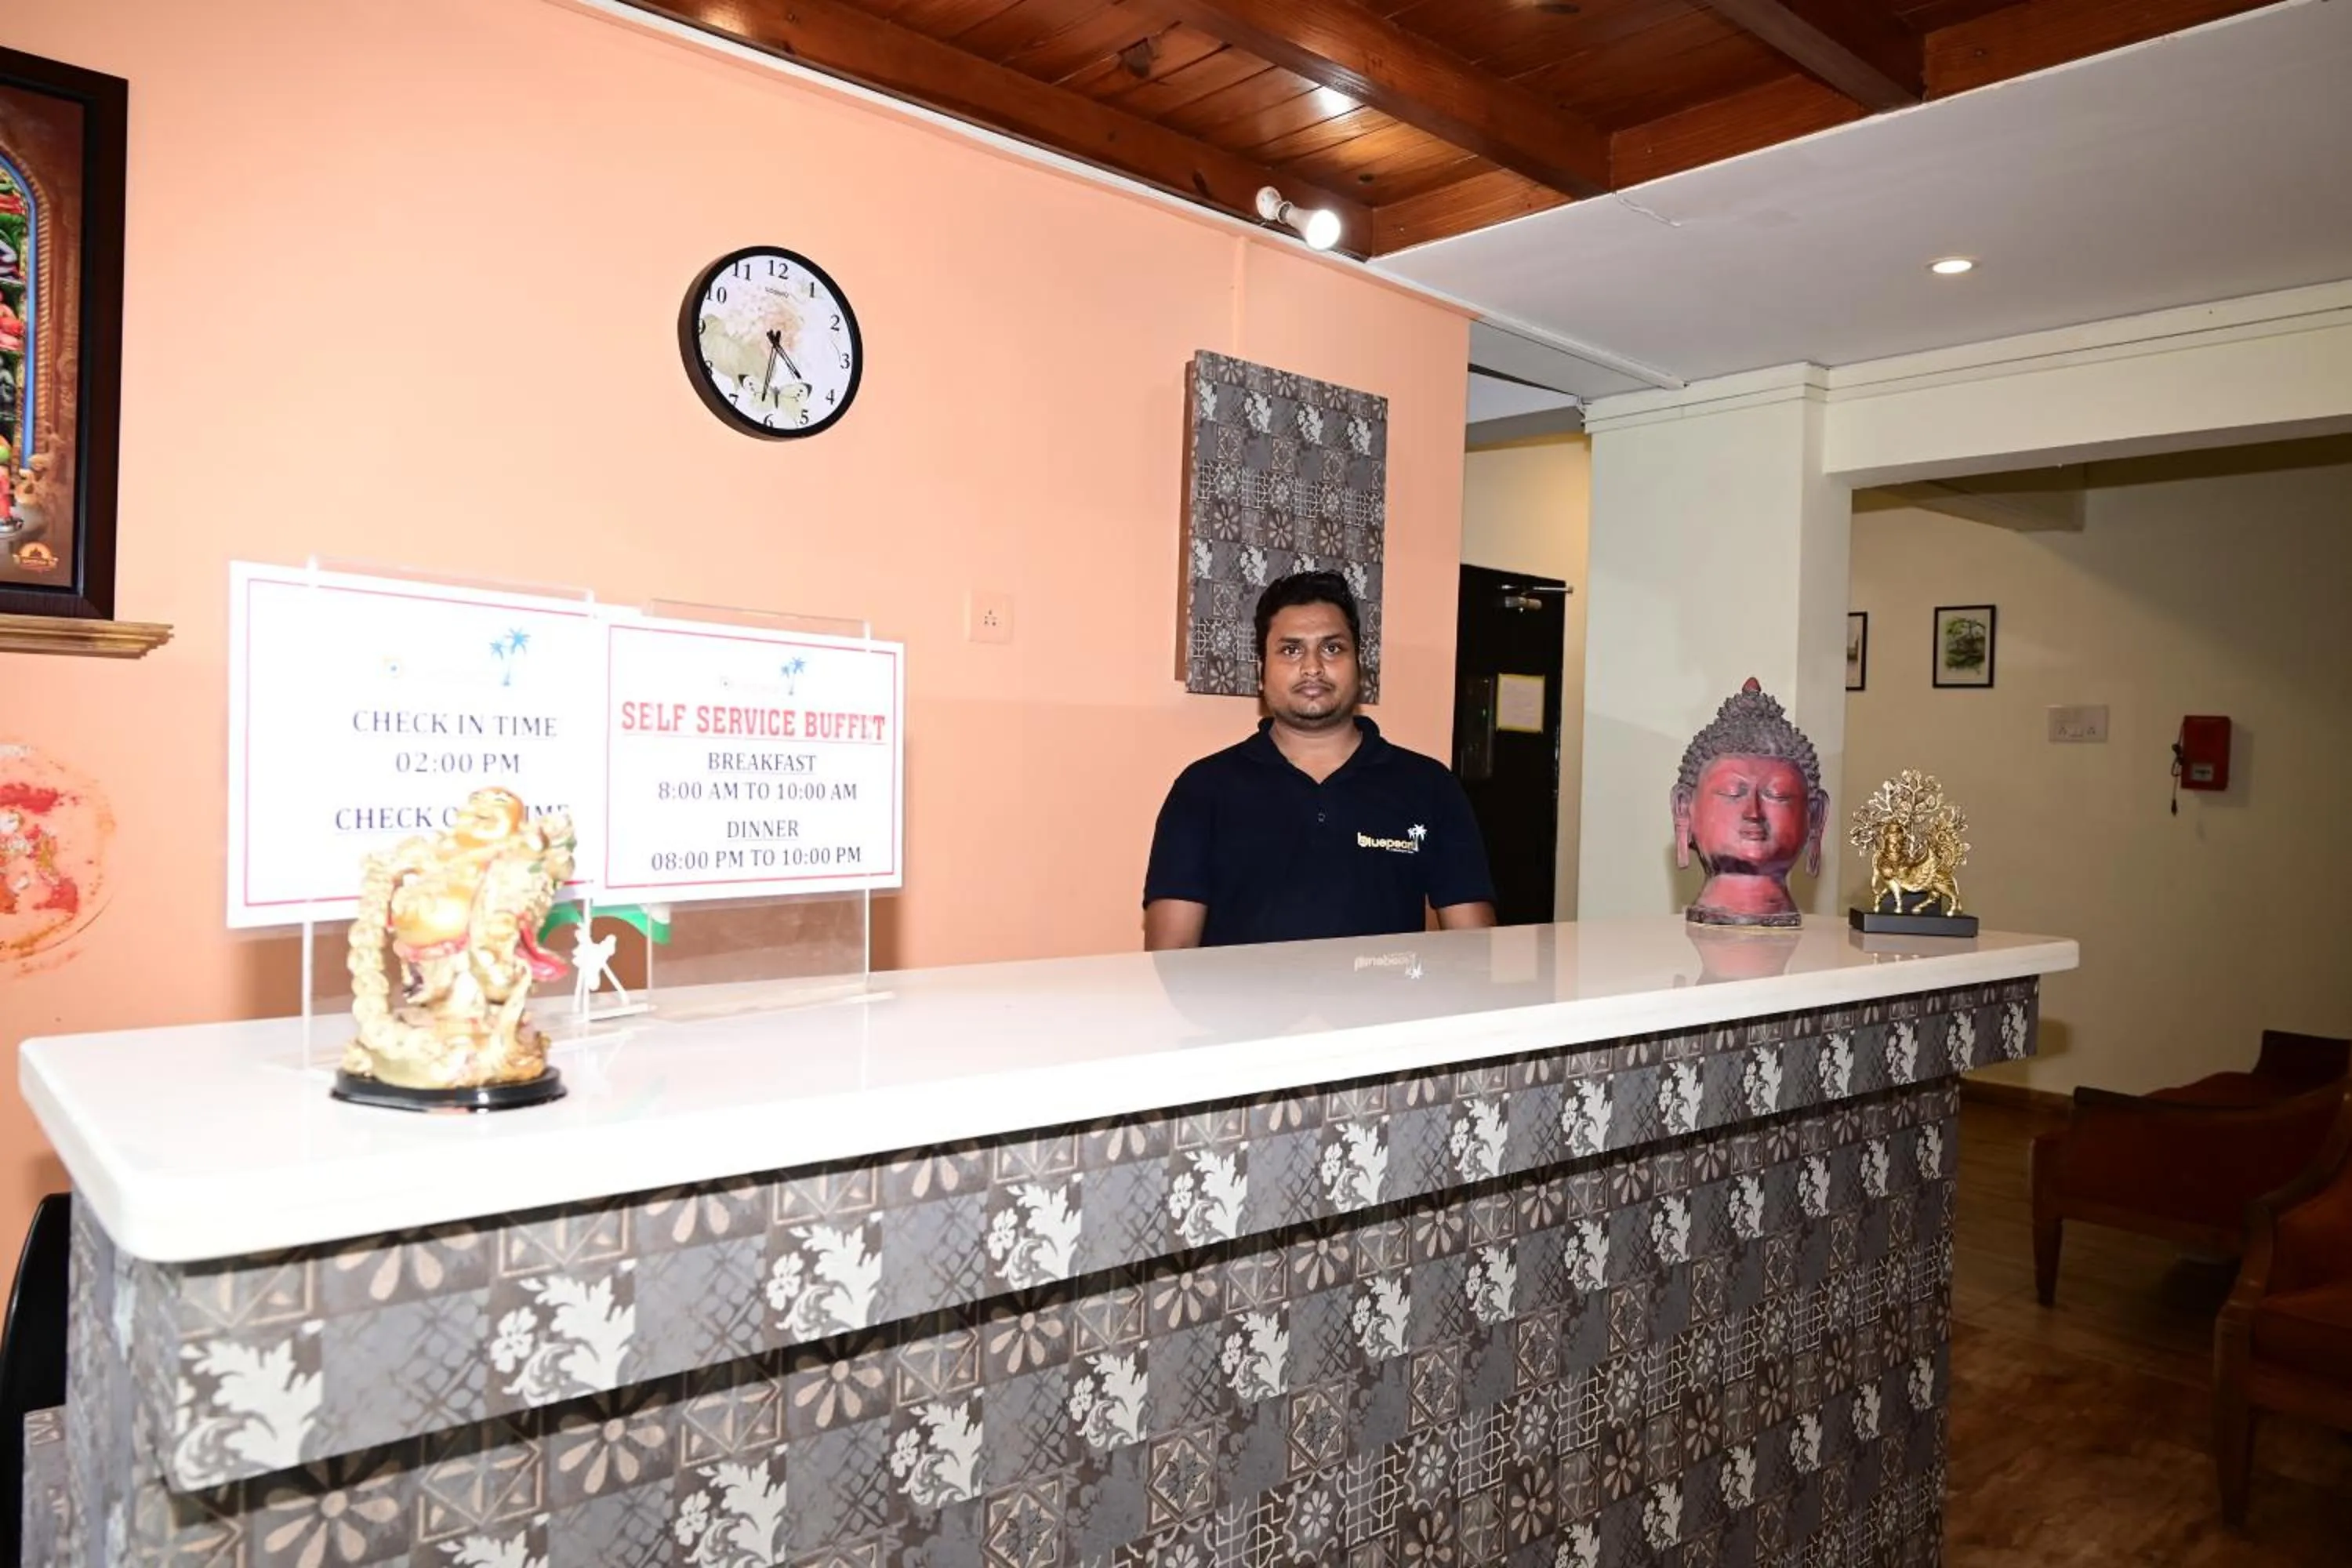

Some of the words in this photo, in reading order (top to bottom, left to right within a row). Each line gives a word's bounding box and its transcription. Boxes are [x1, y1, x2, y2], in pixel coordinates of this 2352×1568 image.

[732, 261, 752, 281] 11
[768, 260, 789, 280] 12
[706, 287, 727, 304] 10
[808, 282, 815, 299] 1
[830, 314, 840, 332] 2
[840, 353, 851, 370] 3
[728, 393, 739, 407] 7
[826, 388, 836, 405] 4
[764, 413, 775, 428] 6
[799, 408, 810, 426] 5
[353, 710, 448, 734] CHECK
[458, 713, 484, 735] IN
[493, 714, 558, 737] TIME
[622, 701, 687, 731] SELF
[696, 705, 796, 737] SERVICE
[395, 751, 473, 773] 02:00
[482, 753, 520, 774] PM
[708, 751, 816, 773] BREAKFAST
[658, 781, 702, 800] 8:00
[709, 782, 739, 800] AM
[744, 782, 770, 800] TO
[777, 782, 826, 800] 10:00
[830, 782, 858, 800] AM
[335, 805, 433, 830] CHECK
[726, 819, 800, 839] DINNER
[651, 851, 709, 871] 08:00
[716, 848, 744, 869] PM
[750, 848, 775, 866] TO
[782, 847, 830, 866] 10:00
[836, 846, 862, 864] PM
